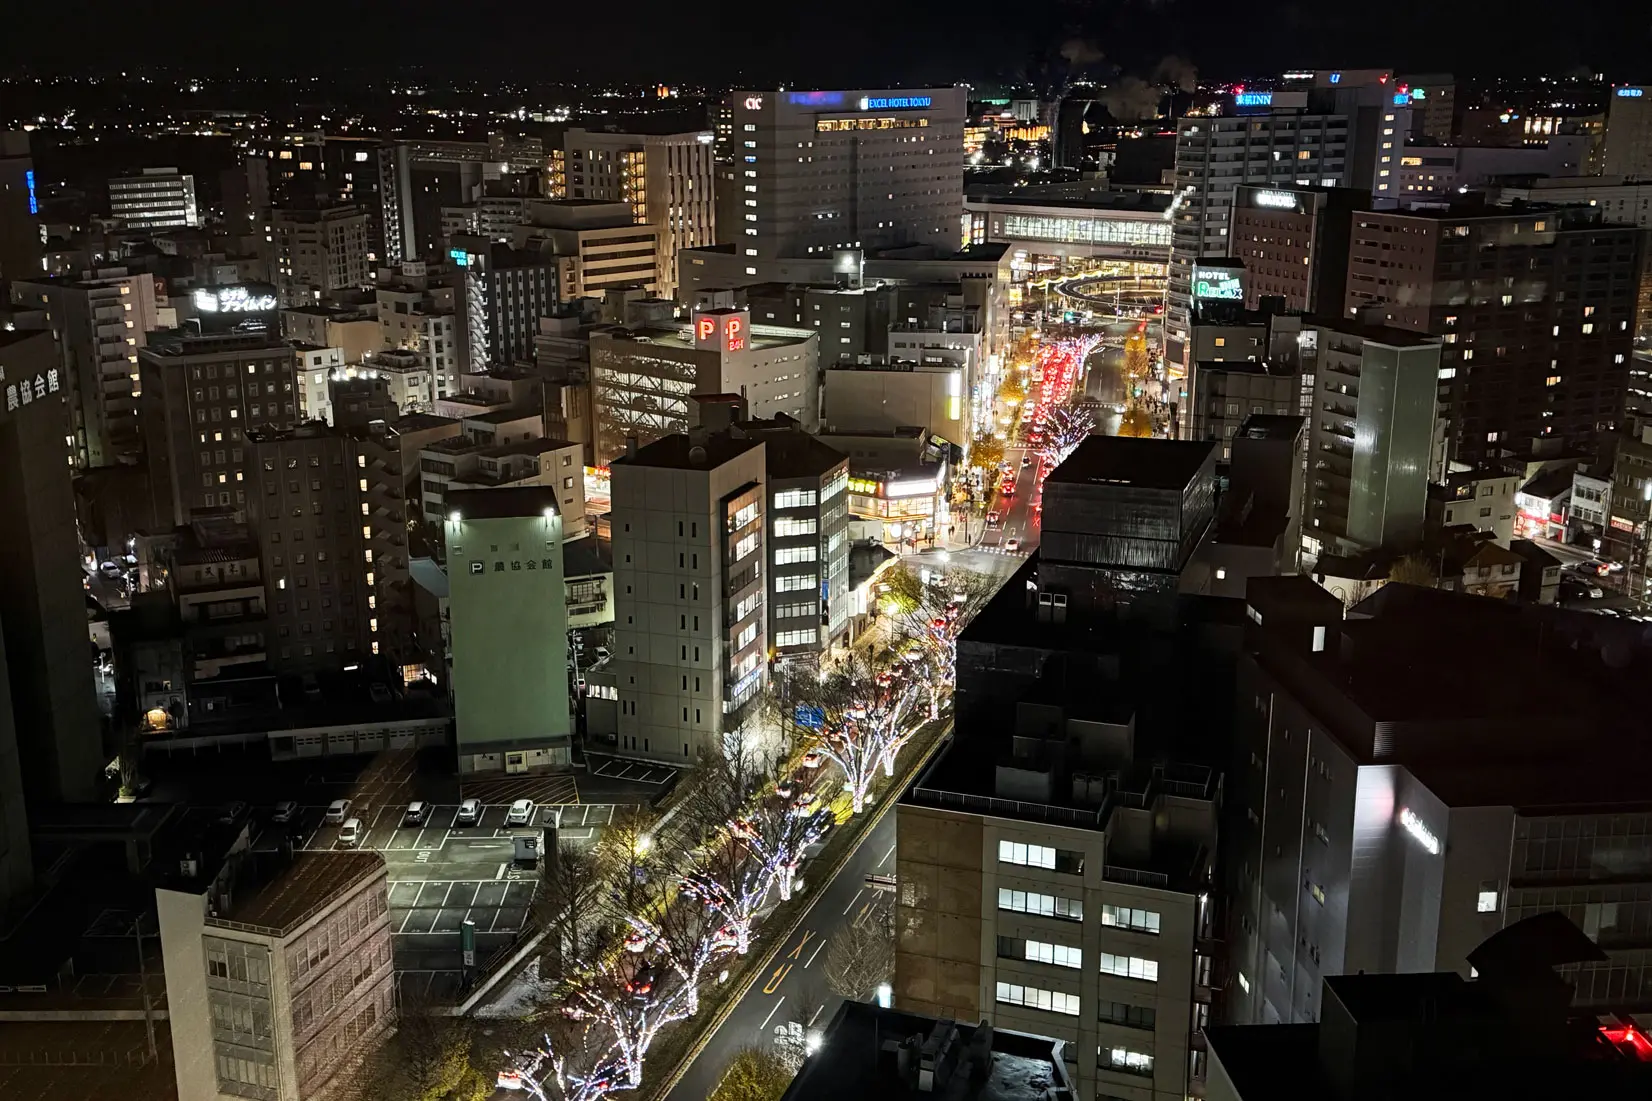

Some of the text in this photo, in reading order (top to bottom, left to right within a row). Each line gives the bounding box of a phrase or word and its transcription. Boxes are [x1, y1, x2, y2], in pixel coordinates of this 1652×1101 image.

[869, 97, 931, 108] EXCEL HOTEL TOKYU
[1198, 271, 1230, 280] HOTEL
[220, 295, 277, 313] プライムイン
[700, 320, 714, 340] P
[728, 320, 741, 340] P
[6, 368, 59, 412] 農協会館
[471, 559, 553, 574] P 農協会館
